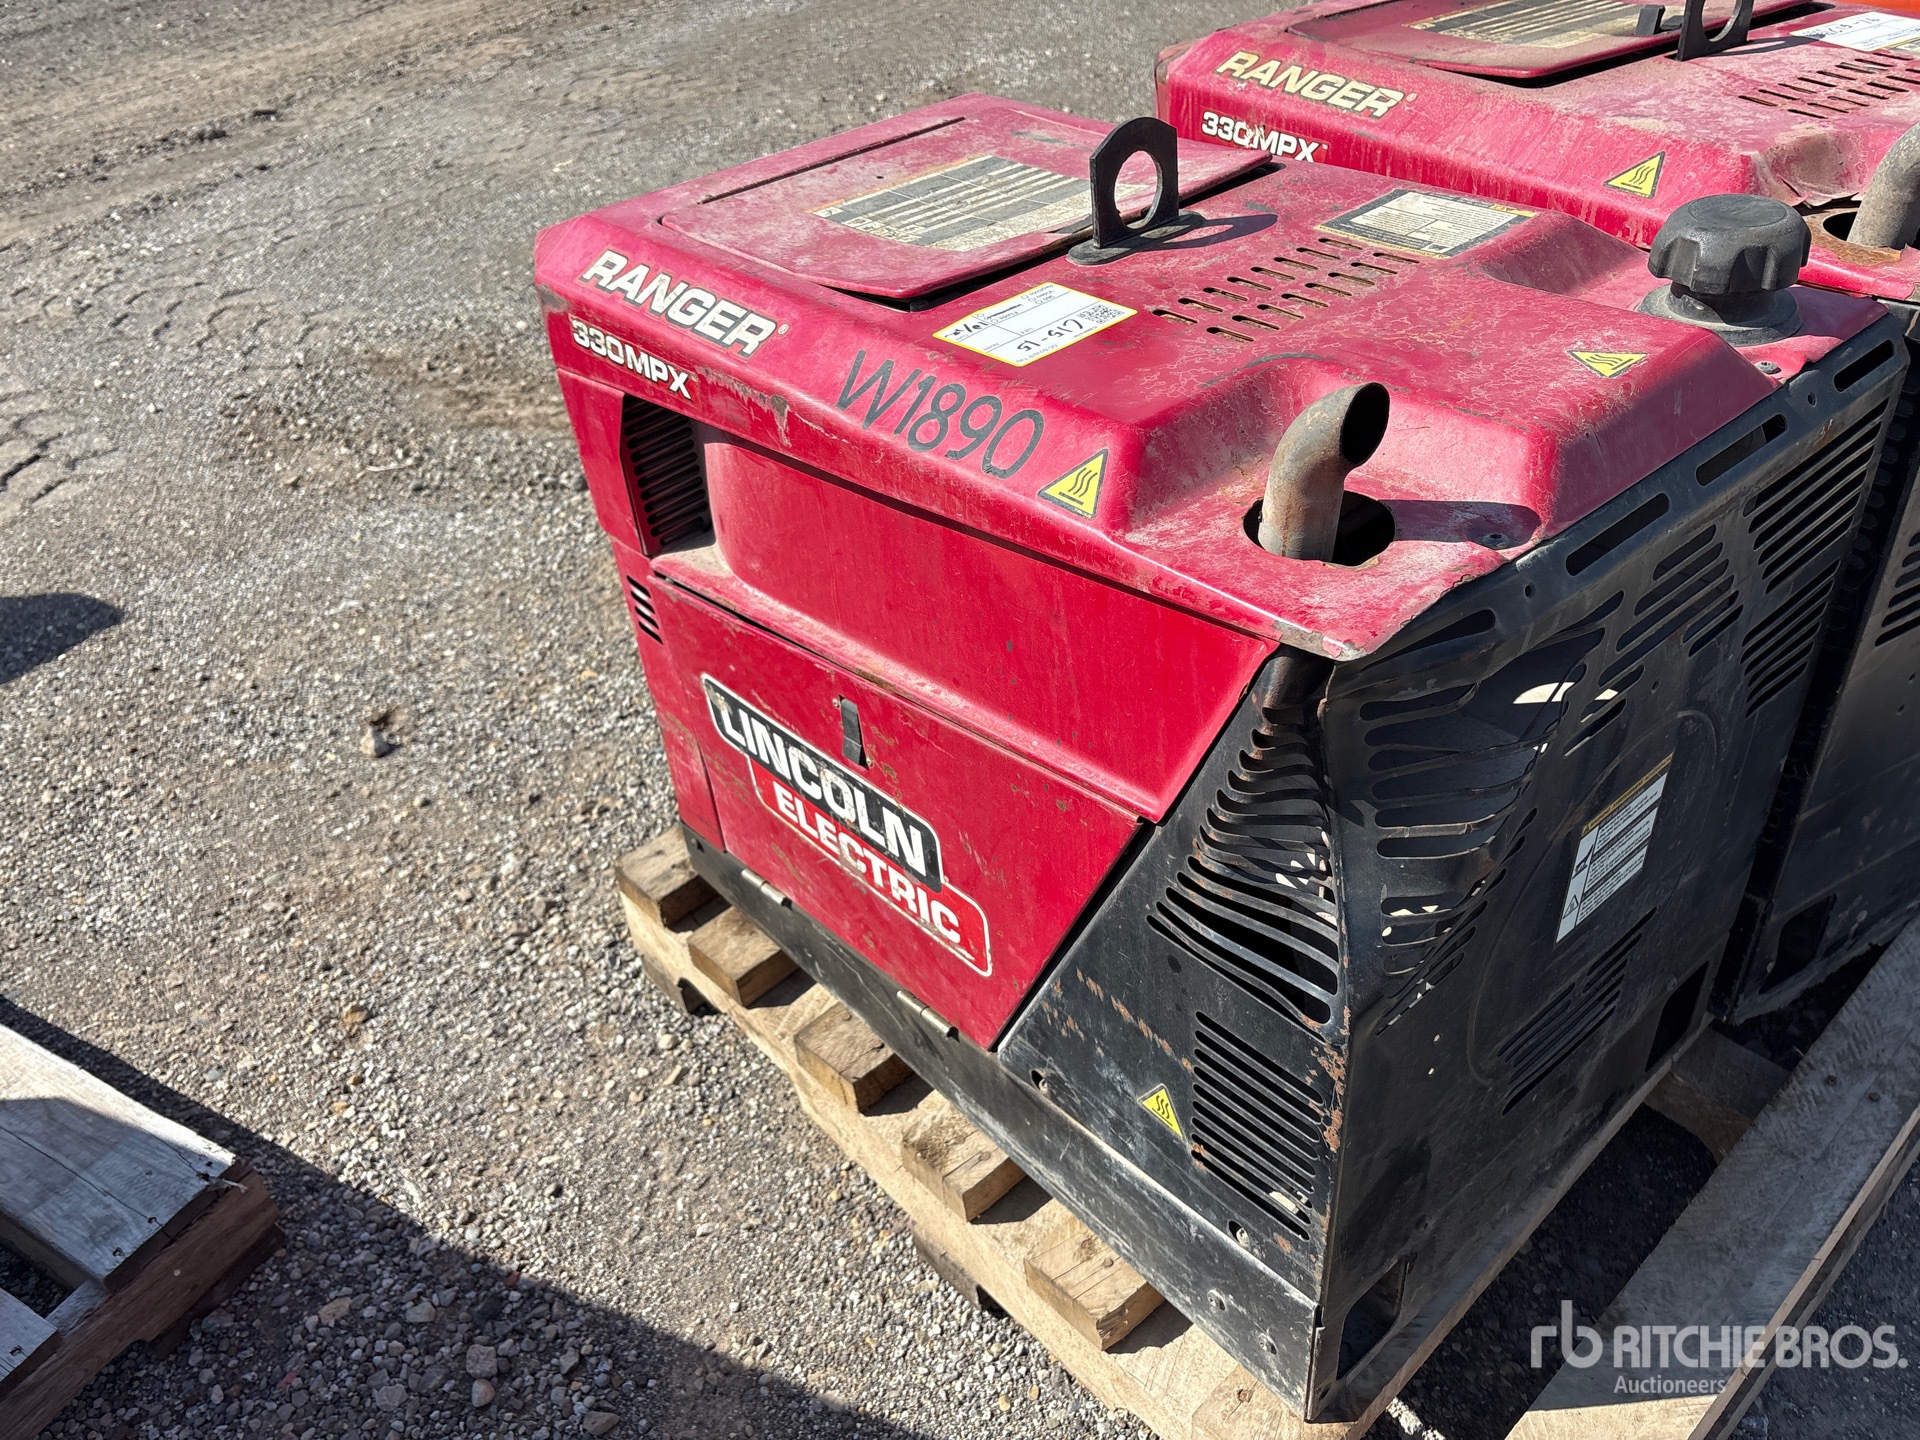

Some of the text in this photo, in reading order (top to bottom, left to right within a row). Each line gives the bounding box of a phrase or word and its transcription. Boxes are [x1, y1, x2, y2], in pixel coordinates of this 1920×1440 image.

[1214, 50, 1405, 119] RANGER
[570, 318, 692, 400] 330MPX
[579, 249, 777, 358] RANGER
[835, 349, 1045, 480] W1890
[718, 696, 928, 878] LINCOLN
[772, 780, 962, 945] ELECTRIC
